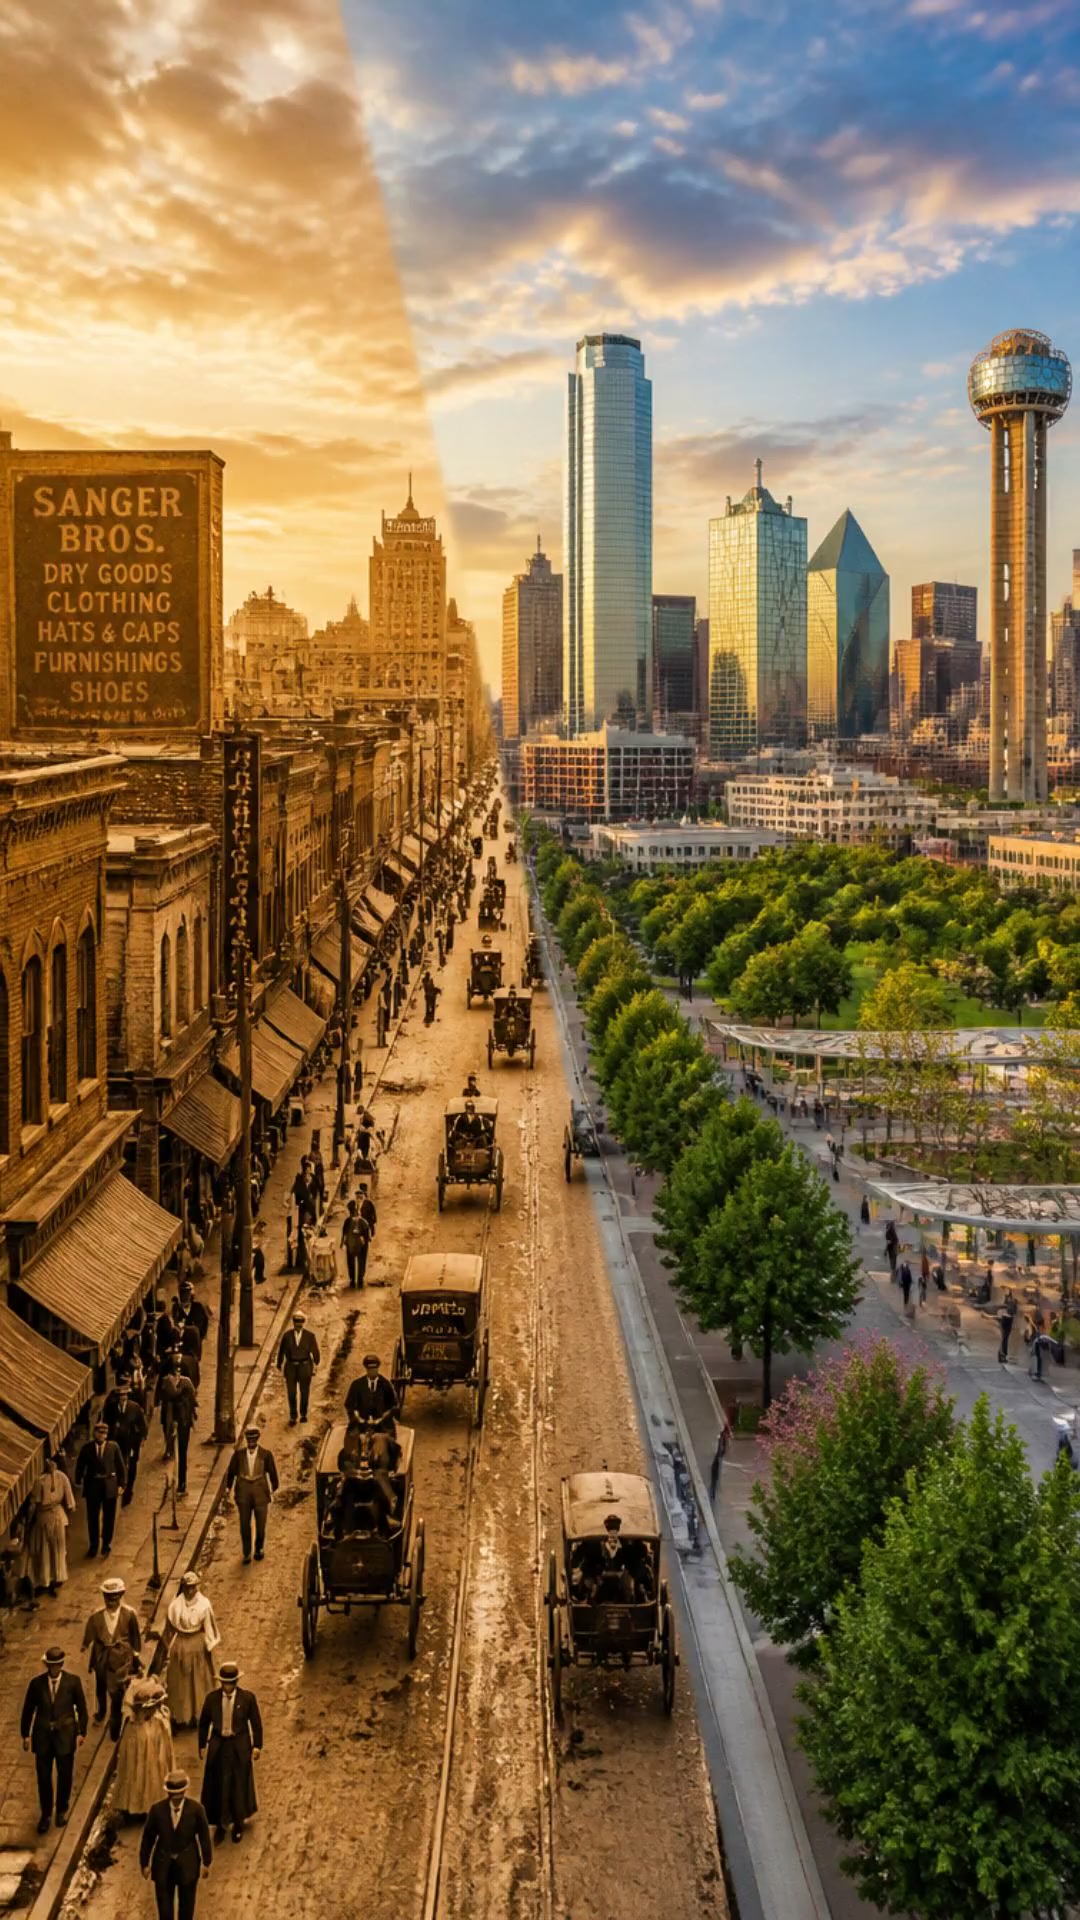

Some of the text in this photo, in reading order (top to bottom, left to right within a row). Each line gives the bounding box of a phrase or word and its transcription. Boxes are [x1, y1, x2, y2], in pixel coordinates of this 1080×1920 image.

[33, 487, 183, 517] SANGER
[59, 524, 165, 553] BROS.
[43, 563, 173, 584] DRY GOODS
[47, 591, 171, 613] CLOTHING
[38, 621, 180, 643] HATS & CAPS
[34, 652, 183, 673] FURNISHINGS
[70, 681, 149, 702] SHOES
